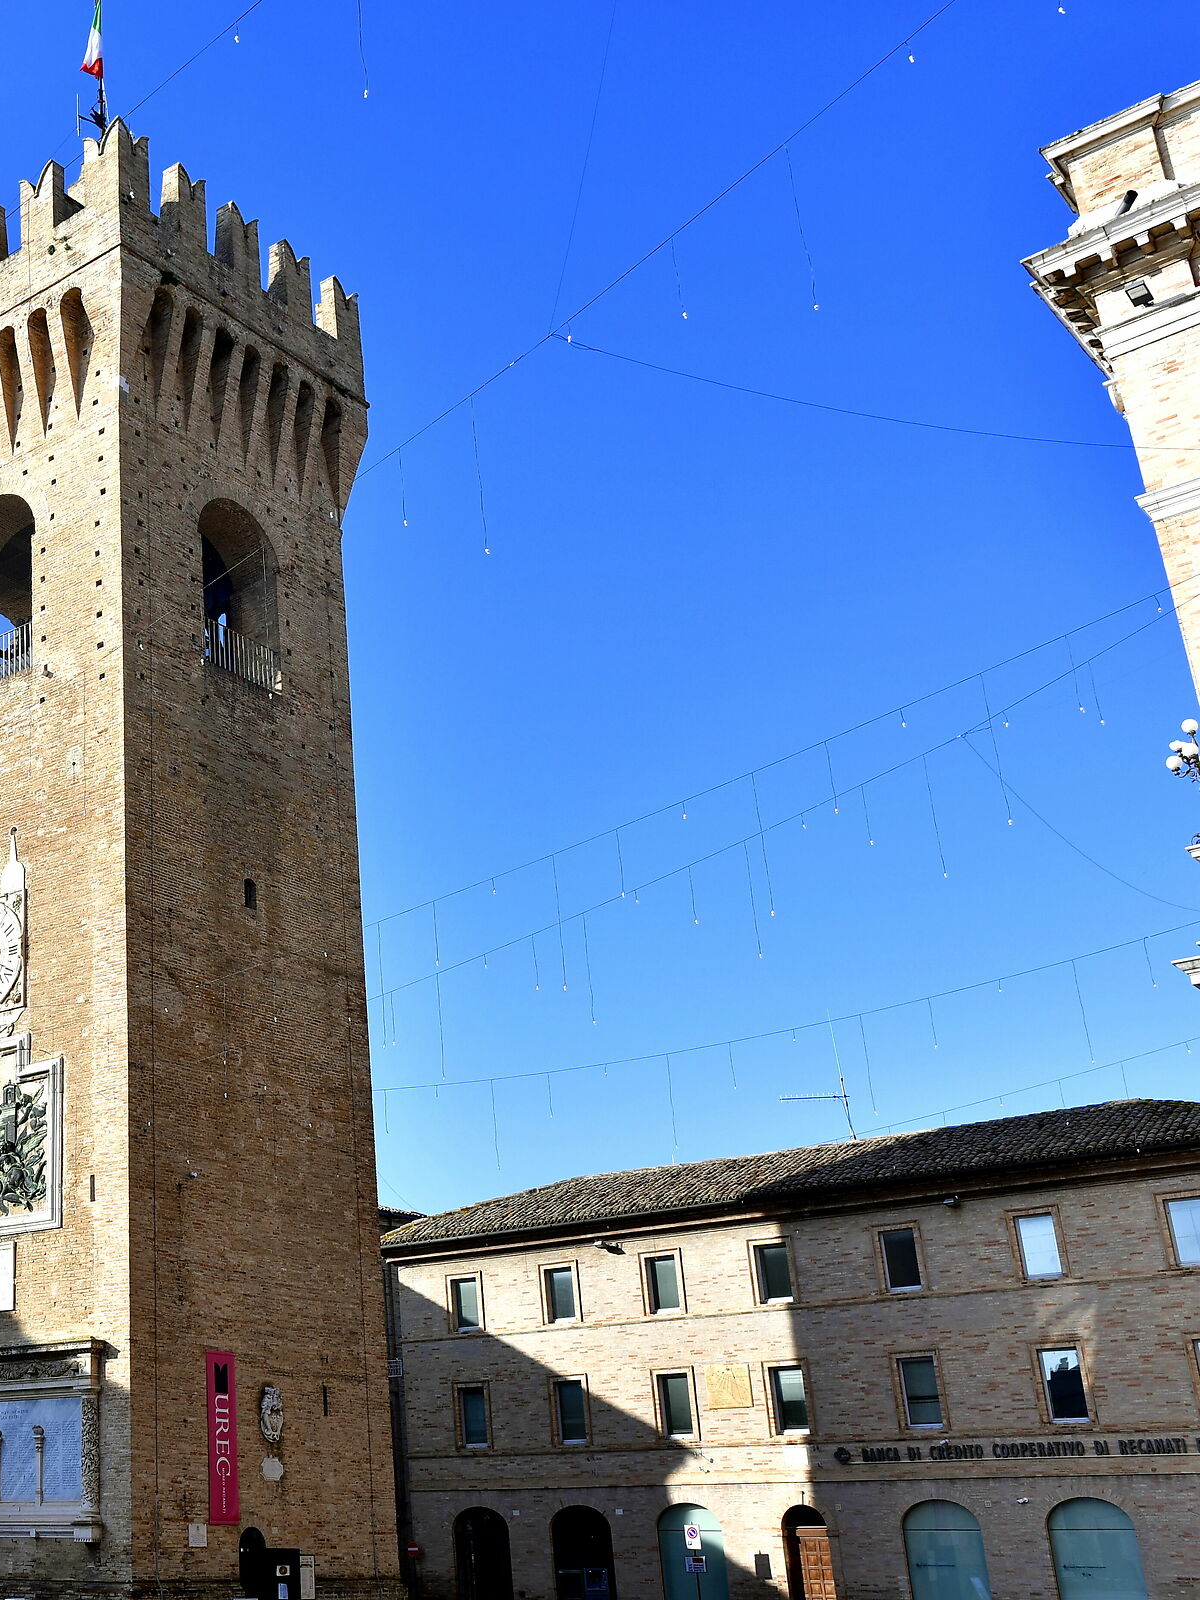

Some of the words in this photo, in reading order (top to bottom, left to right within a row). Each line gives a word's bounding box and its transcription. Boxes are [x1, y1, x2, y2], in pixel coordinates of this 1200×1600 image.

[4, 923, 15, 937] II
[8, 944, 19, 956] III
[861, 1447, 900, 1462] BANCA
[907, 1446, 921, 1461] DI
[929, 1444, 983, 1460] CREDITO
[992, 1440, 1085, 1458] COOPERATIVO
[1094, 1440, 1110, 1456] DI
[1118, 1438, 1188, 1455] RECANATI
